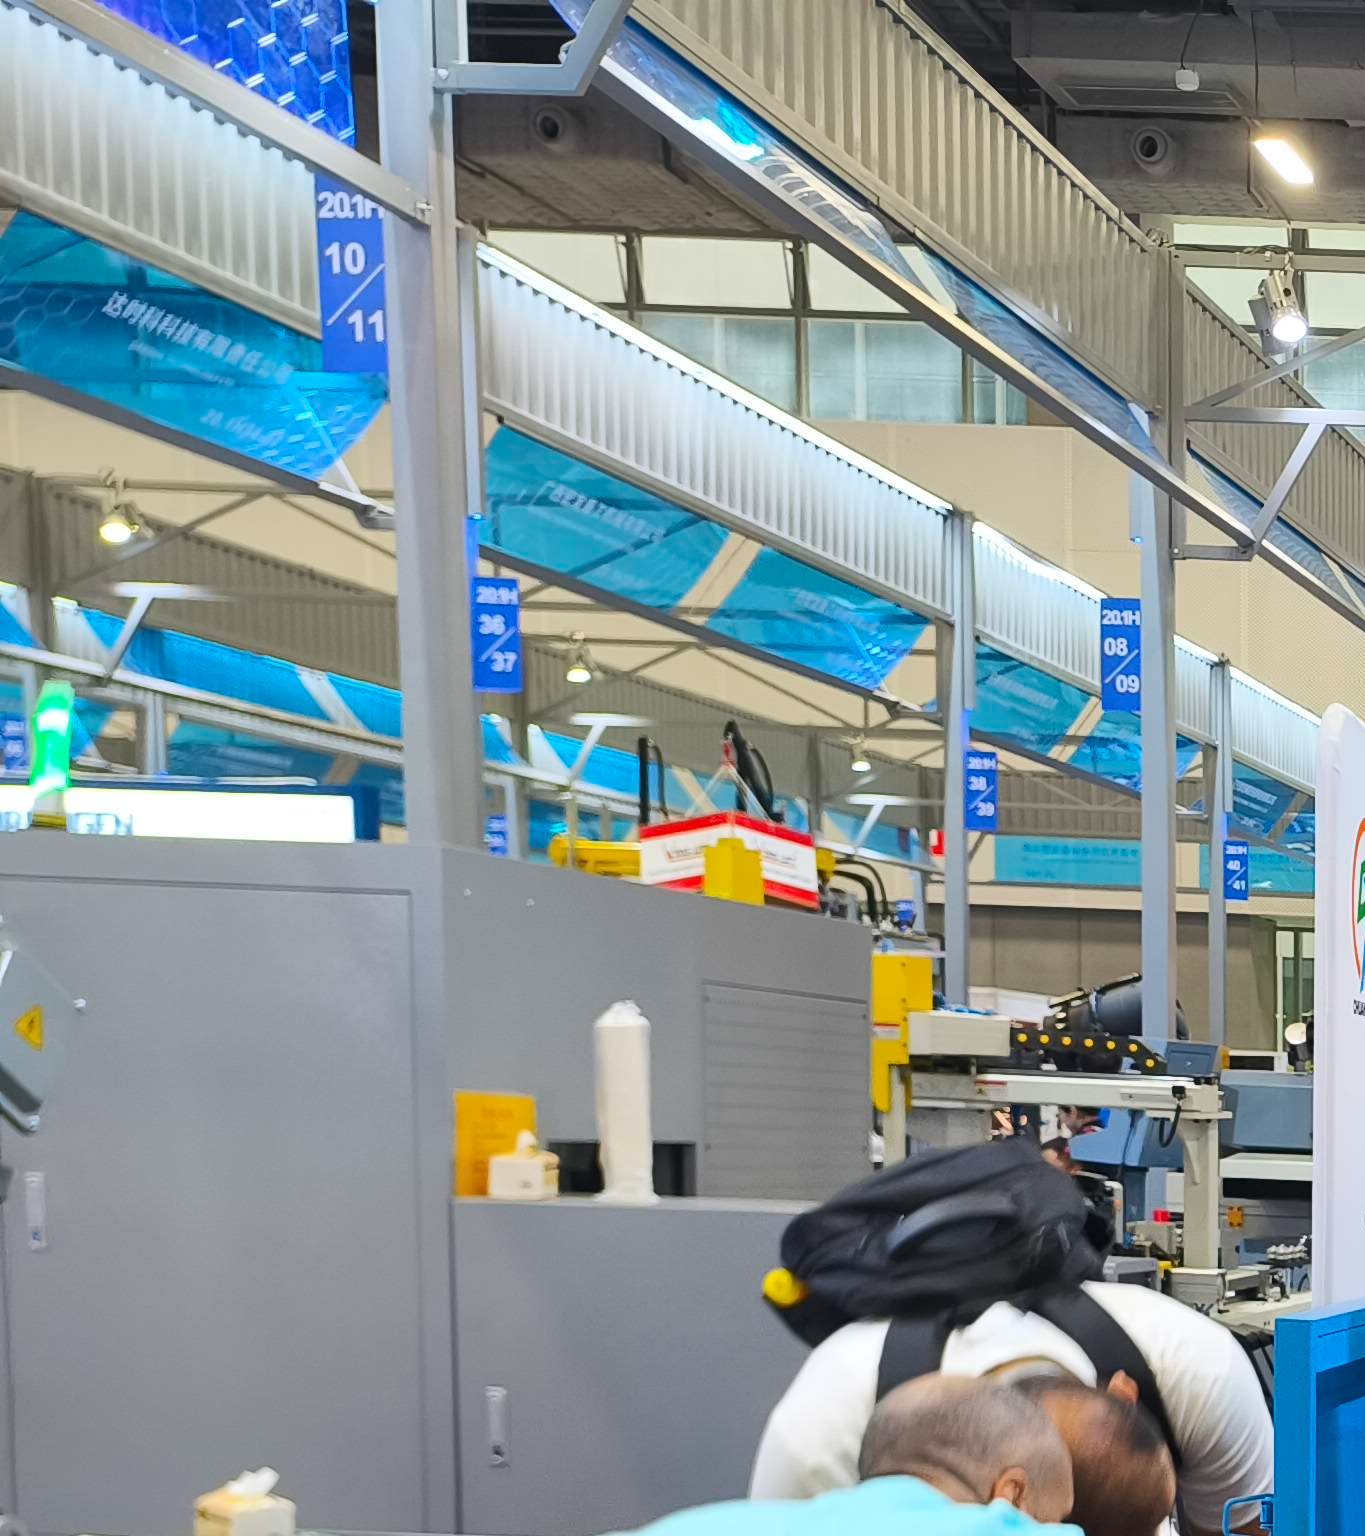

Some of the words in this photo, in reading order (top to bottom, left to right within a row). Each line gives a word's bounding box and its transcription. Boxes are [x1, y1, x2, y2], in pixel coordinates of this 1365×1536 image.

[325, 242, 366, 274] 10
[347, 310, 385, 342] 11
[1102, 609, 1140, 626] 20.1H
[1104, 637, 1128, 656] 08
[1115, 674, 1139, 693] 09
